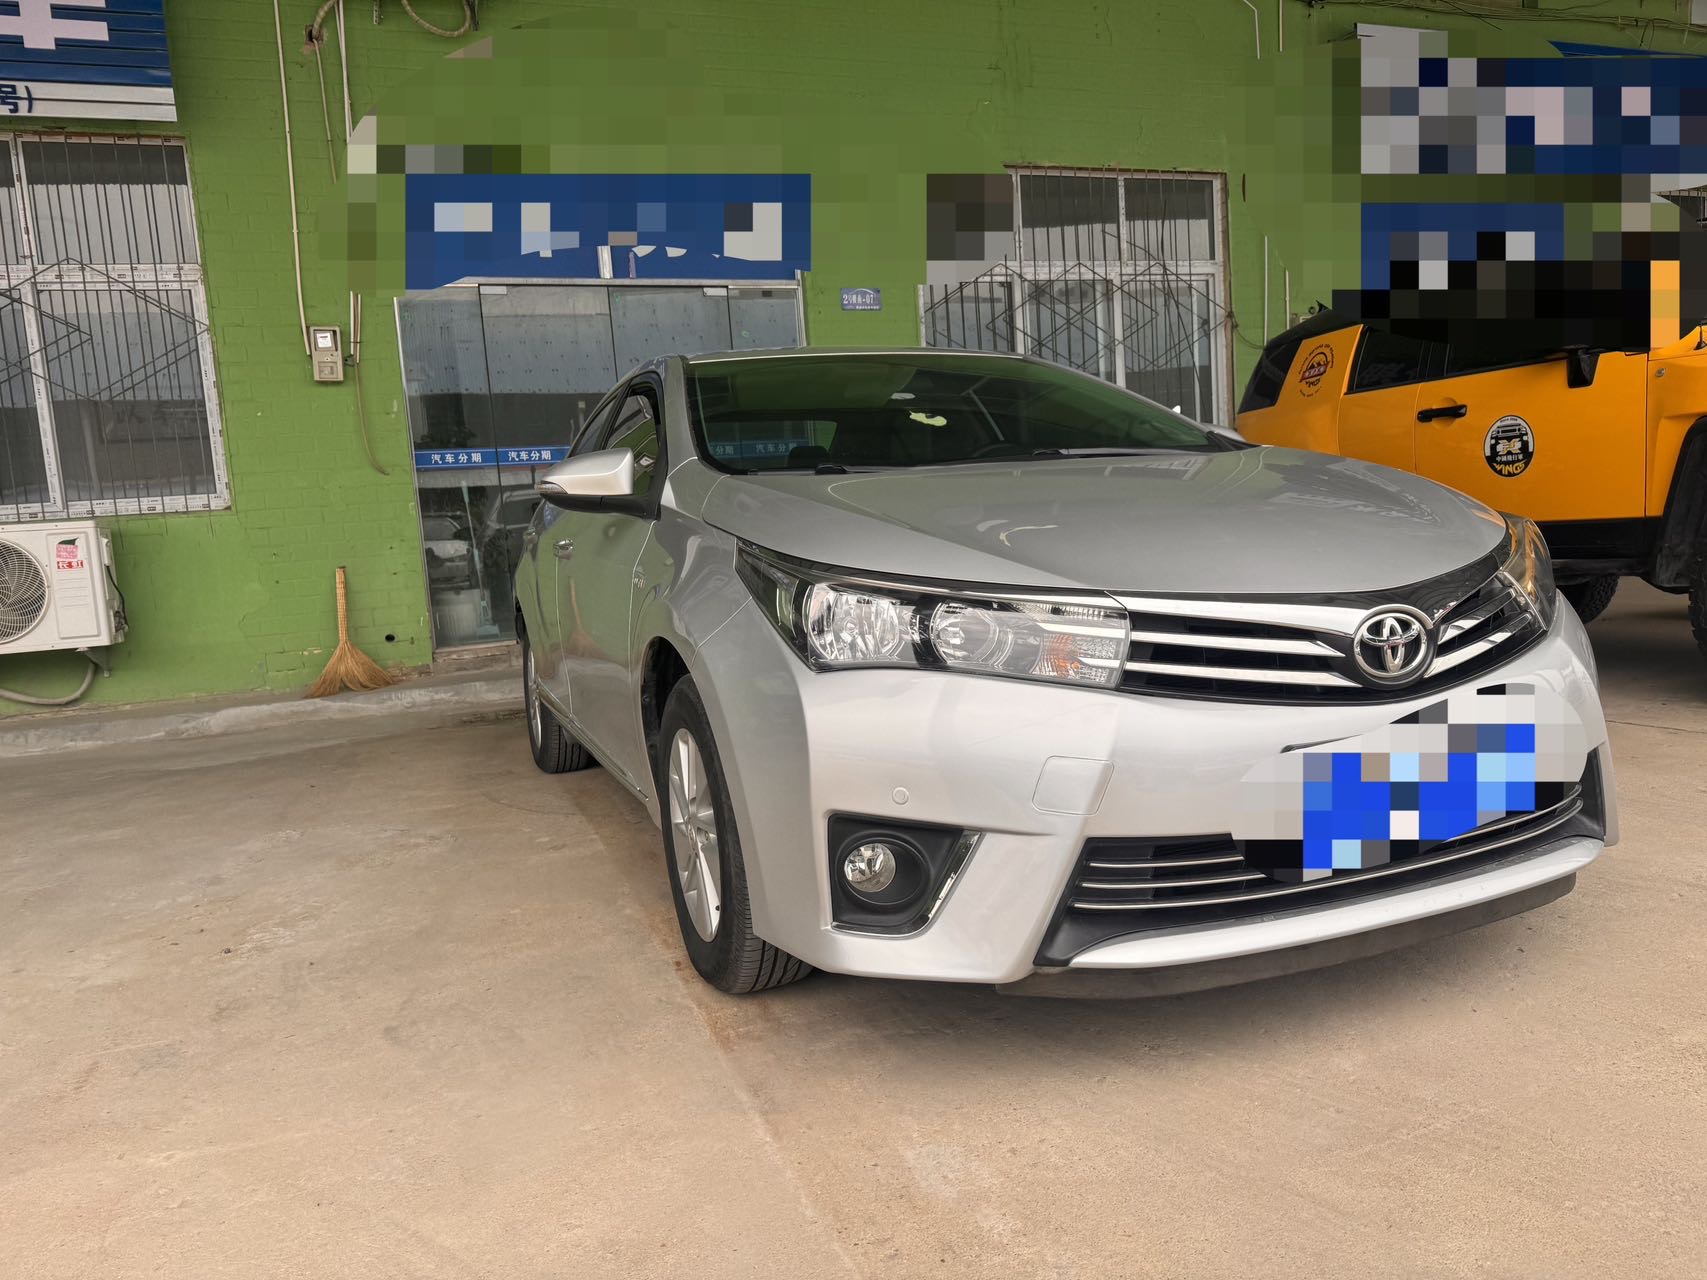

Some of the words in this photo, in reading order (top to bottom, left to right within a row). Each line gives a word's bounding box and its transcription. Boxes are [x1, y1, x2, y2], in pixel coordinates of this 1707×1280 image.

[431, 453, 482, 464] 汽车分期
[508, 450, 552, 461] 汽车分期
